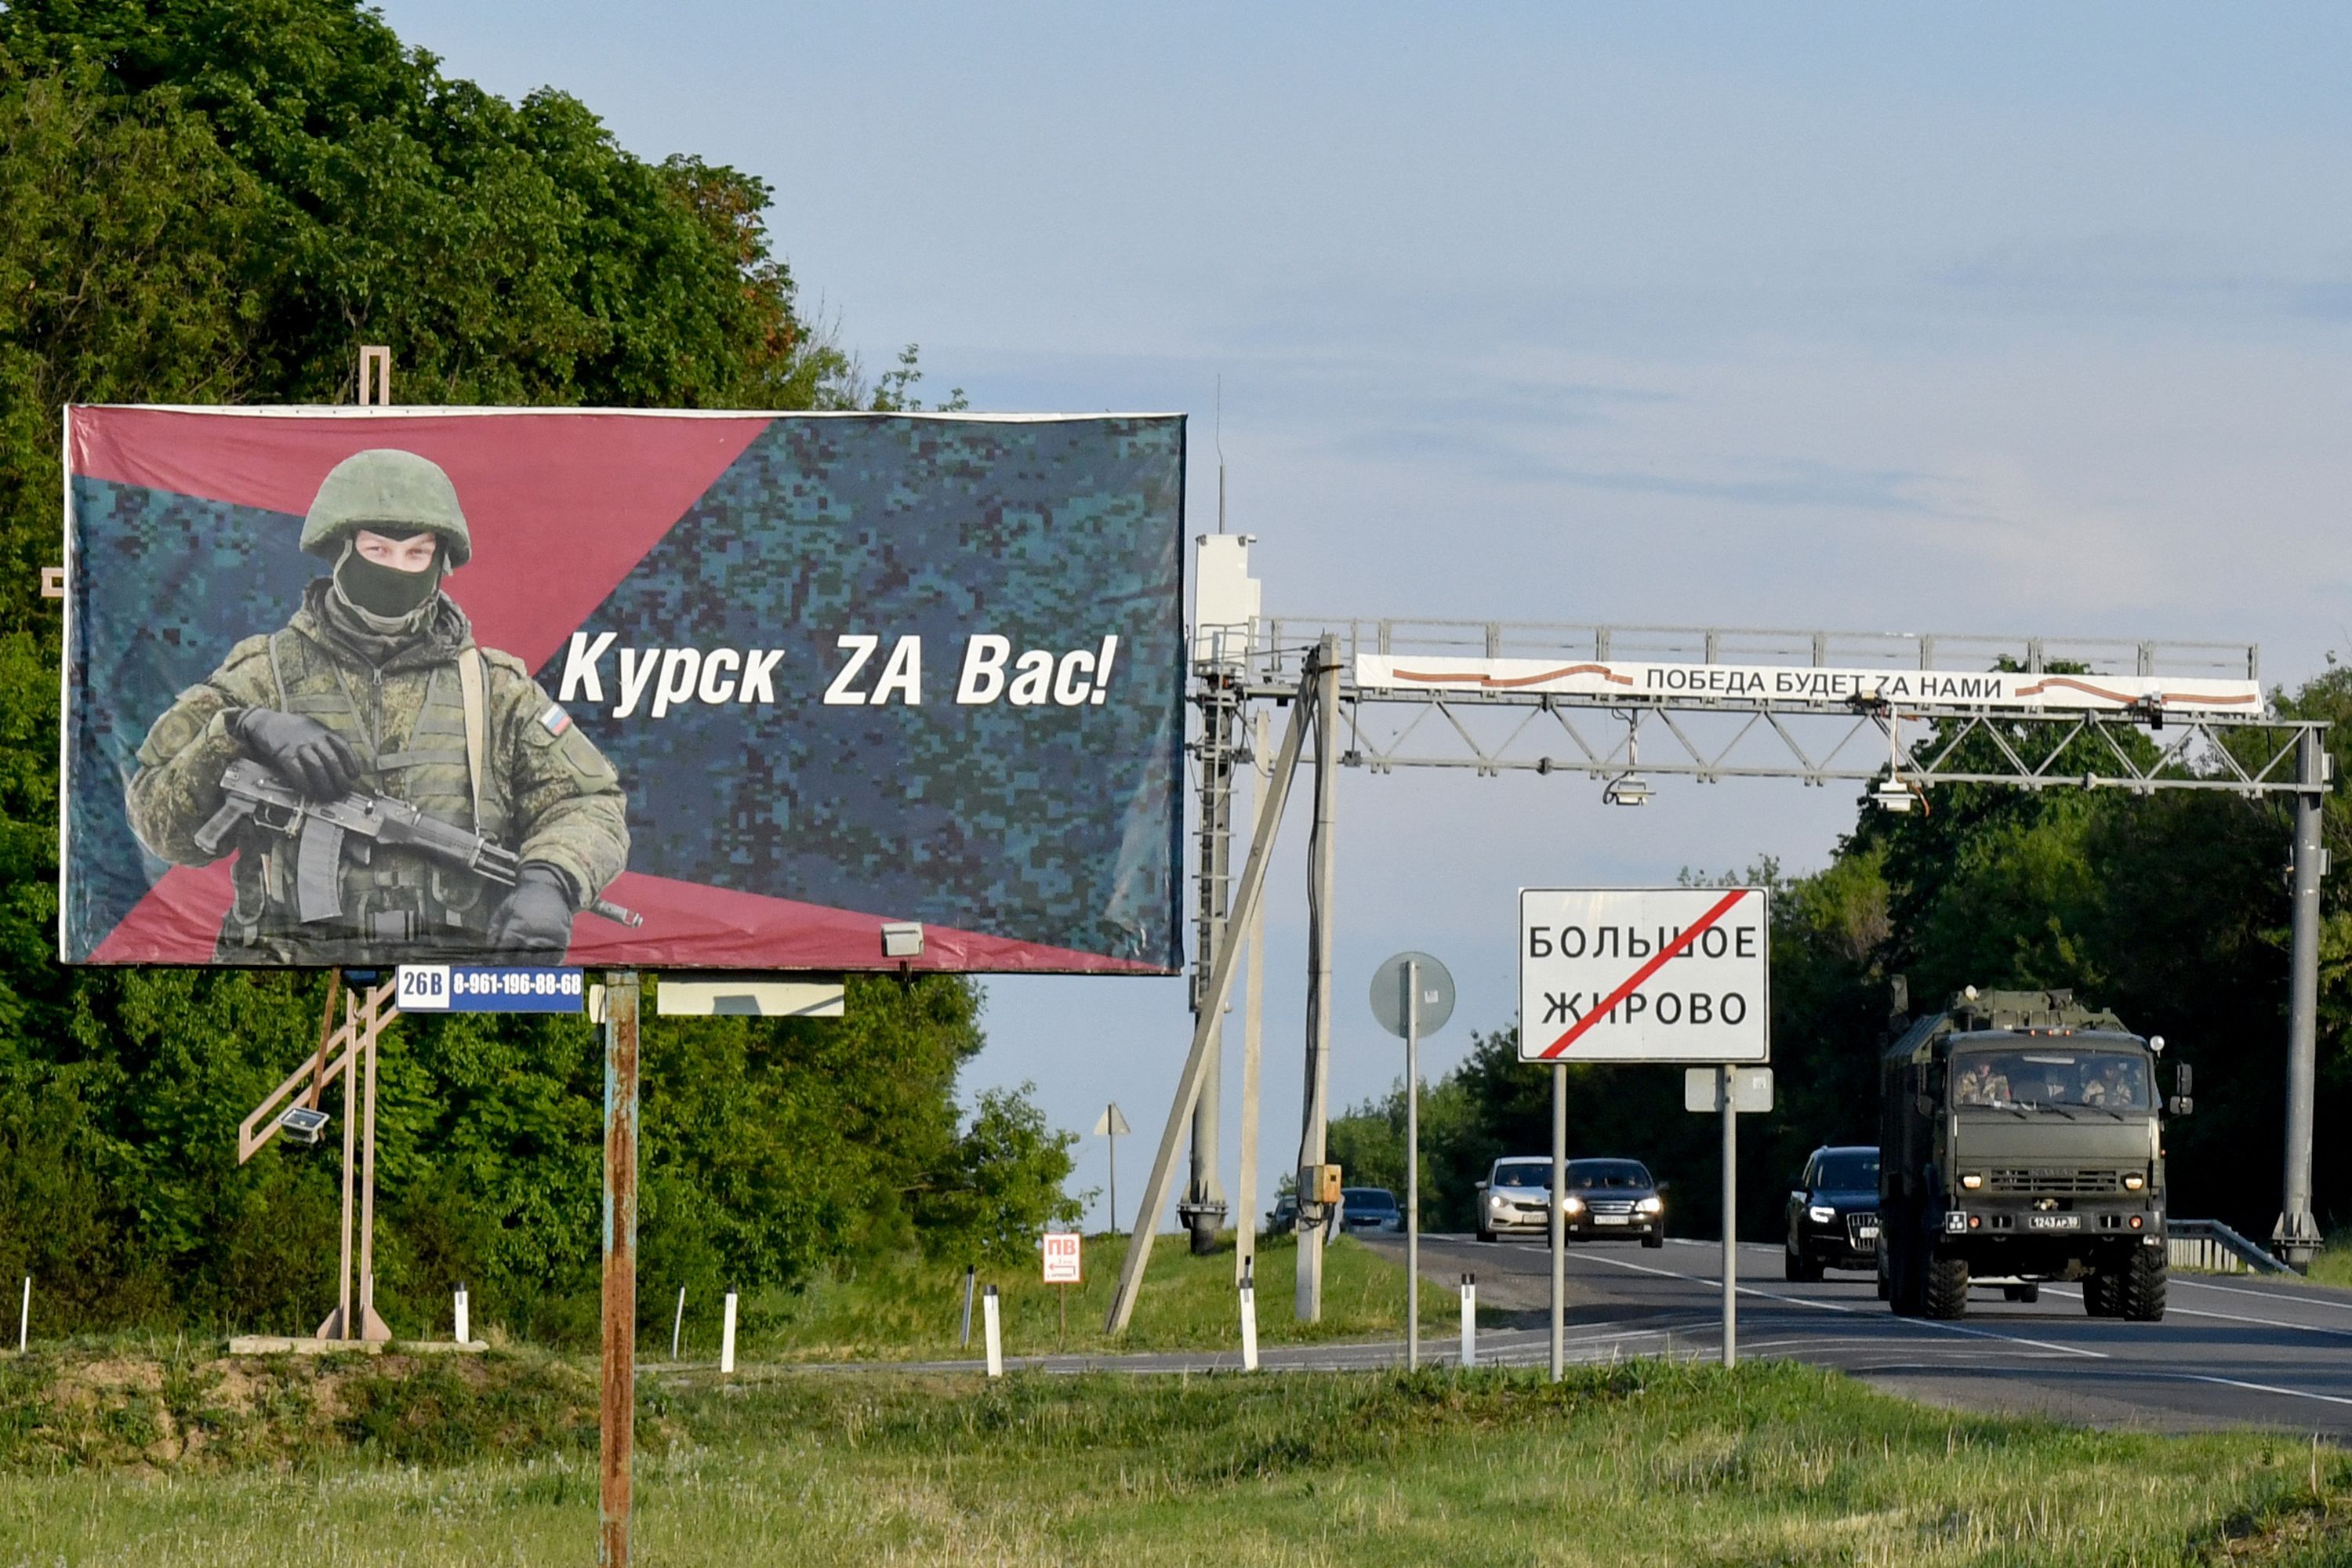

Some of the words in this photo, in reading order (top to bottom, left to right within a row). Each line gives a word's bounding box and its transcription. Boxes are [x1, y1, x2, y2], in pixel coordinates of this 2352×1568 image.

[558, 632, 785, 718] Курск
[823, 634, 922, 705] ZA
[956, 634, 1119, 706] Вас!
[1646, 668, 1766, 694] ПОБЕДА
[1776, 672, 1865, 697] БУДЕТ
[1920, 677, 2002, 699] НАМИ
[1530, 926, 1756, 958] БОЛЬШОЕ
[453, 972, 581, 995] 8-961-196-88-68
[1047, 1239, 1076, 1255] ПВ
